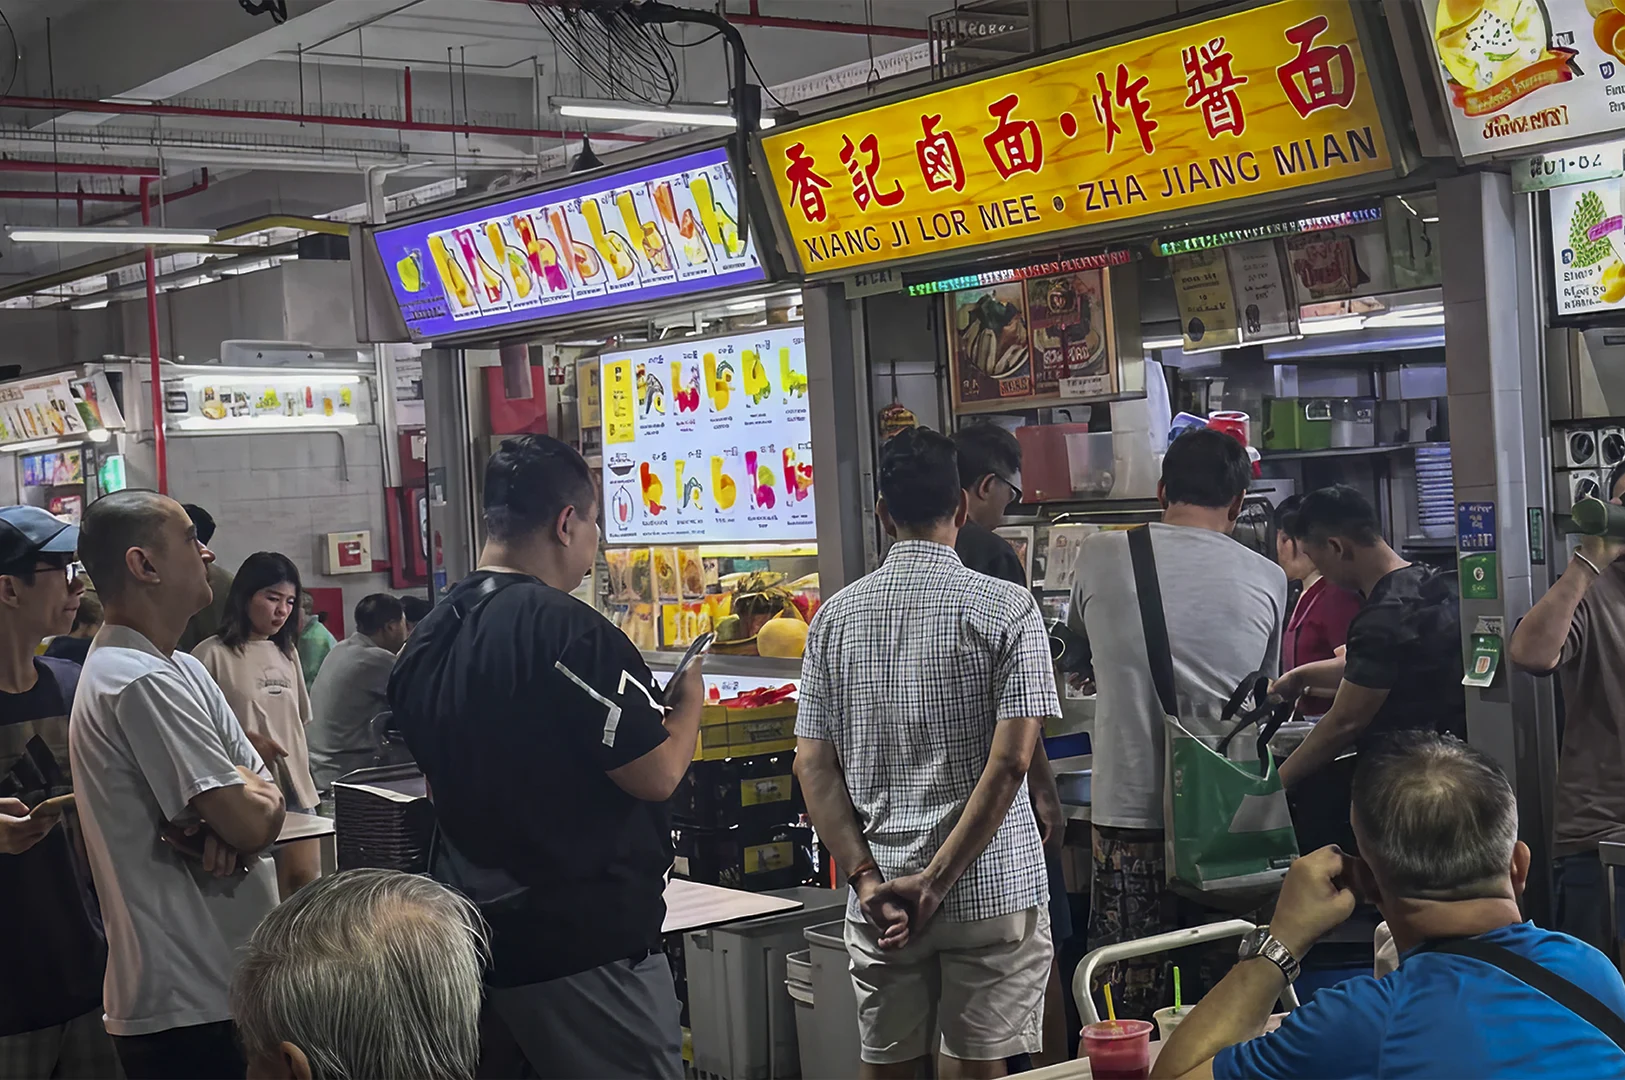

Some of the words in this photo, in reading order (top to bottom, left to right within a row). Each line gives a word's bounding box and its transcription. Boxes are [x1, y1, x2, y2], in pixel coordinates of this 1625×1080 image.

[803, 226, 881, 262] XIANG
[891, 220, 910, 248] JI
[916, 209, 971, 241] LOR
[978, 195, 1041, 231] MEE
[1078, 174, 1148, 212] ZHA
[1160, 151, 1261, 198] JIANG
[1272, 126, 1378, 176] MIAN
